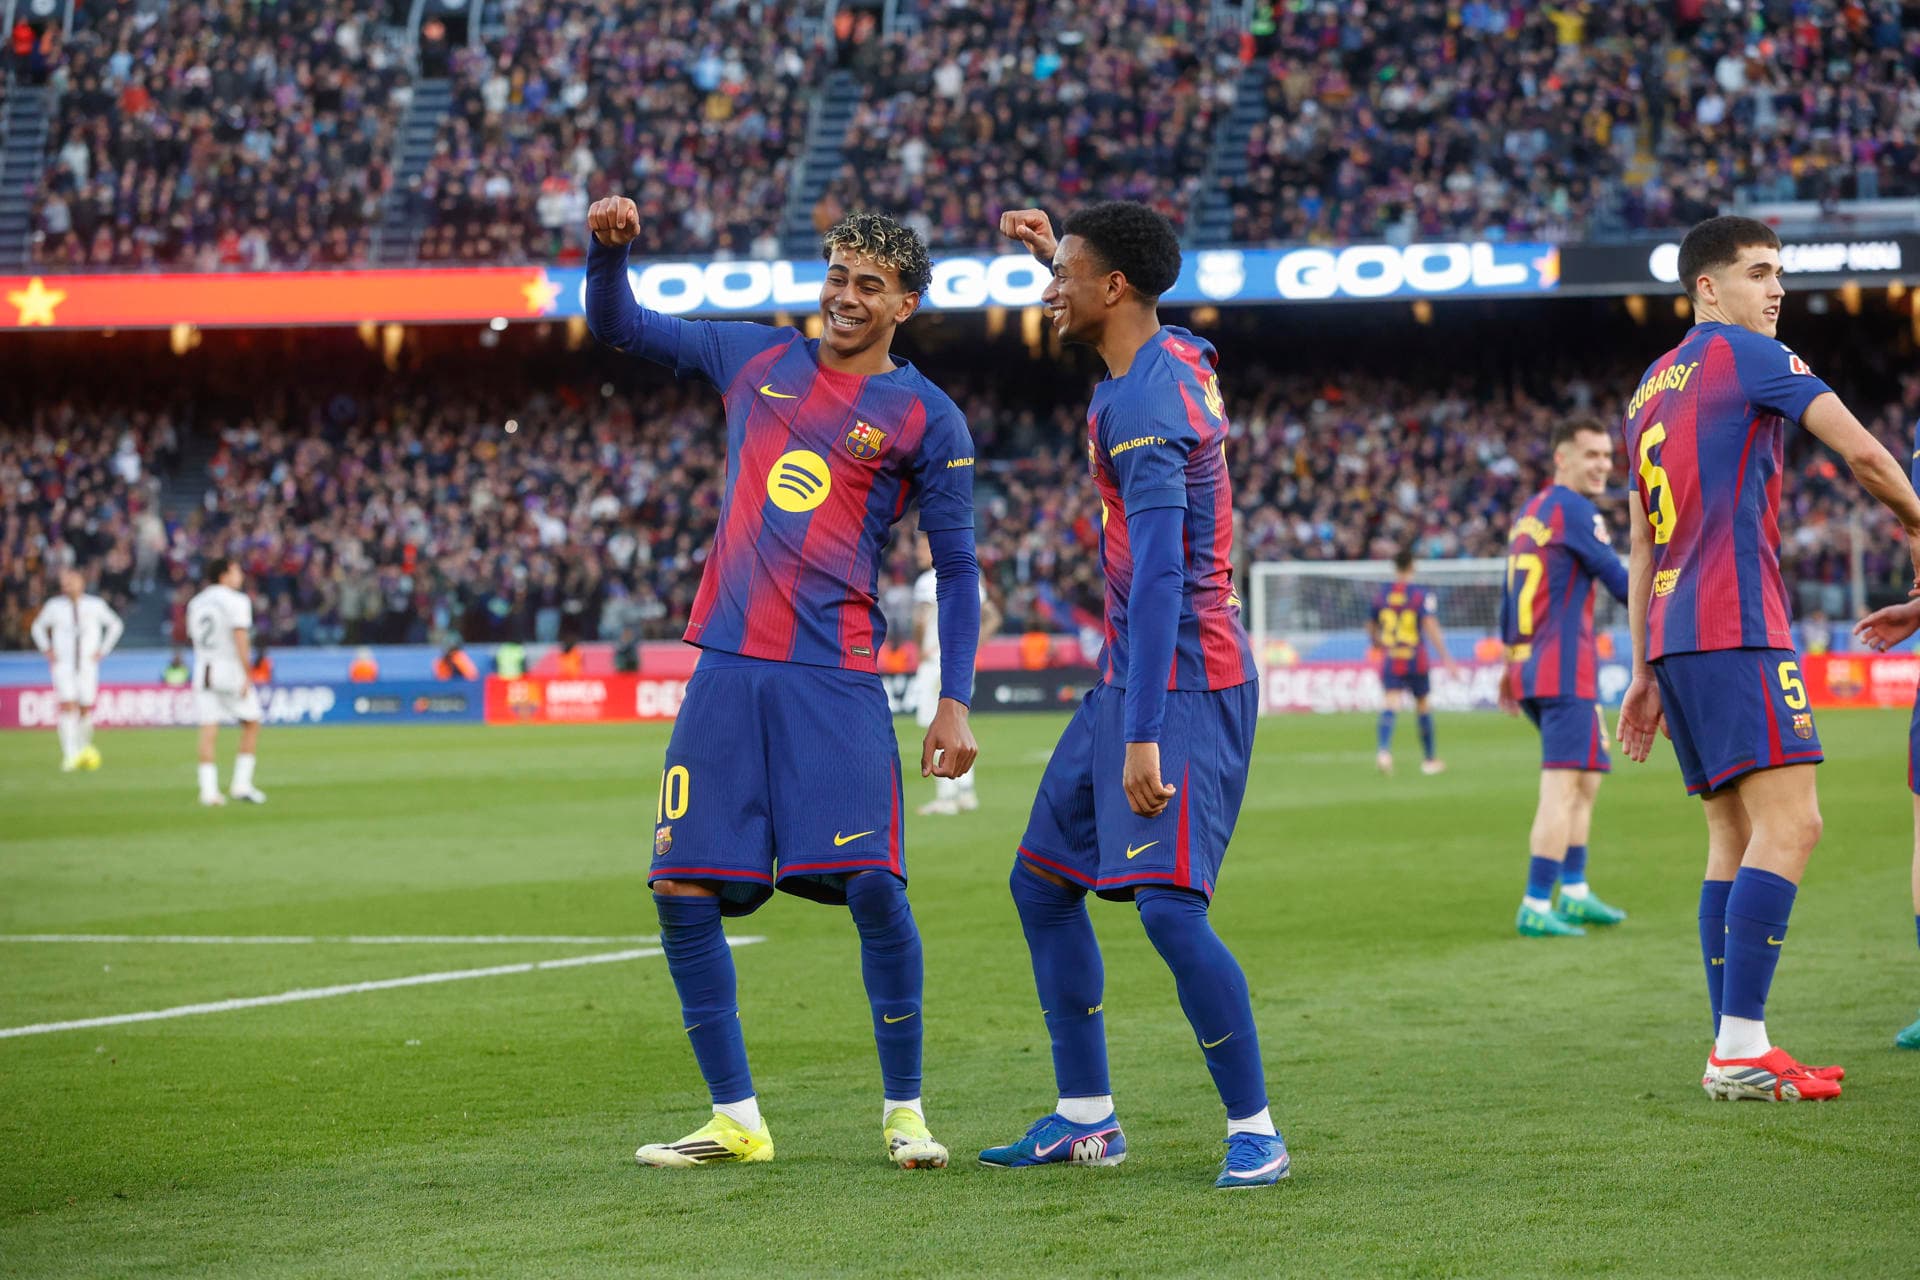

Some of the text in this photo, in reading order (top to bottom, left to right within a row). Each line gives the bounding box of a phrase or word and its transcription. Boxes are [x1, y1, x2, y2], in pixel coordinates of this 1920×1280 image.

[579, 261, 827, 314] OOL
[1275, 242, 1529, 300] GOOL
[1639, 422, 1677, 544] 5
[1507, 552, 1544, 636] 17
[200, 616, 218, 650] 2
[1777, 661, 1807, 710] 5
[656, 765, 690, 825] 10
